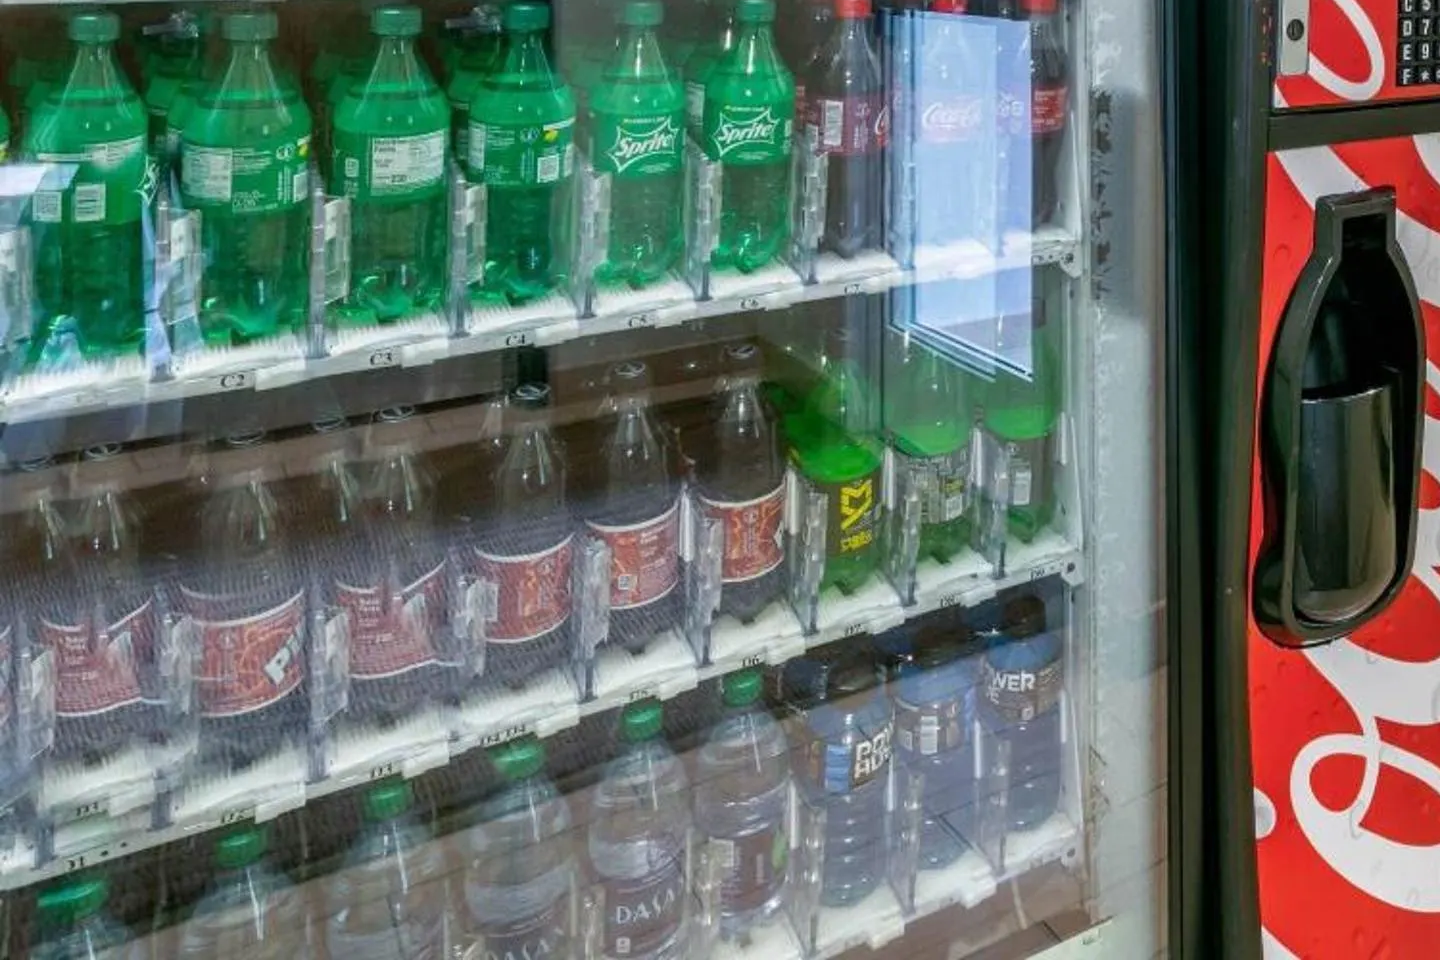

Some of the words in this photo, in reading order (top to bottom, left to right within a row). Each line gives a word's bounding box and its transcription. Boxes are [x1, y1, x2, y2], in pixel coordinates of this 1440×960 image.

[1403, 20, 1413, 36] D
[1421, 19, 1430, 35] 7
[1403, 44, 1412, 61] E
[1421, 43, 1430, 59] 9
[1402, 69, 1412, 86] F
[718, 122, 773, 145] Sprite
[614, 132, 674, 159] Sprite
[505, 333, 526, 347] C4
[369, 351, 393, 366] C3
[220, 373, 245, 389] C2
